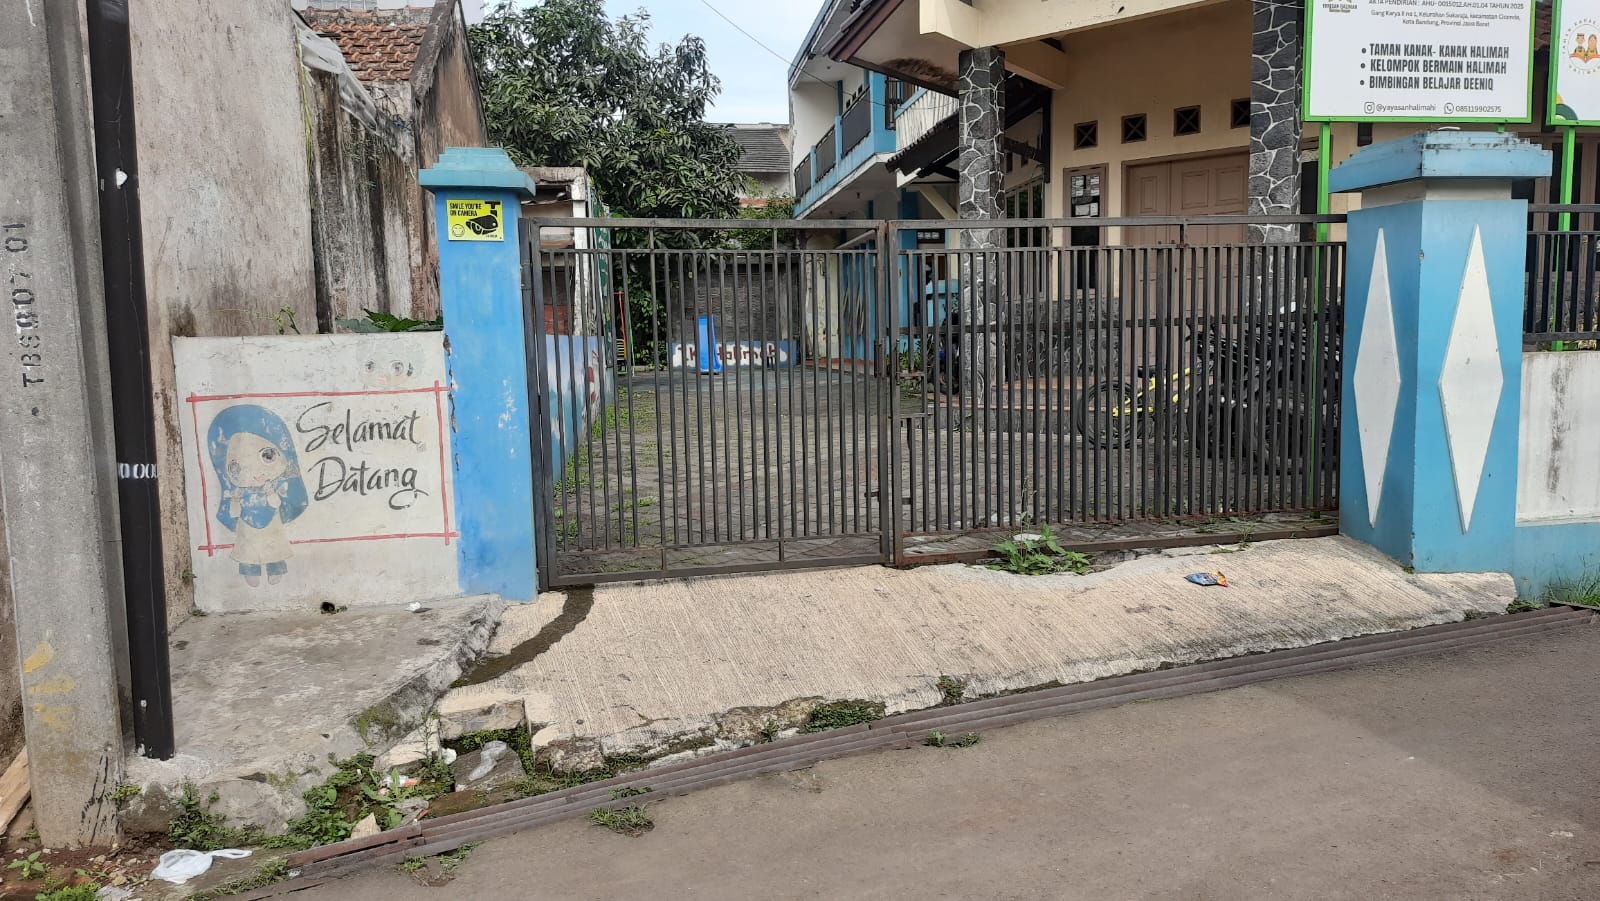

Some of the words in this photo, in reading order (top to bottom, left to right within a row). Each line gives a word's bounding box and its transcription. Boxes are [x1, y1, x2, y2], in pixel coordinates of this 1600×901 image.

[1369, 43, 1401, 57] TAMAN
[1439, 45, 1468, 58] KANAK
[1470, 46, 1510, 59] HALIMAH
[1370, 58, 1420, 73] KELOMPOK
[1422, 60, 1464, 74] BERMAIN
[1466, 61, 1507, 74] HALIMAH
[1369, 75, 1420, 89] BIMBINGAN
[1422, 76, 1461, 90] BELAJAR
[1463, 77, 1494, 91] DEENIQ
[296, 401, 421, 452] Selamat
[308, 456, 429, 510] Datang
